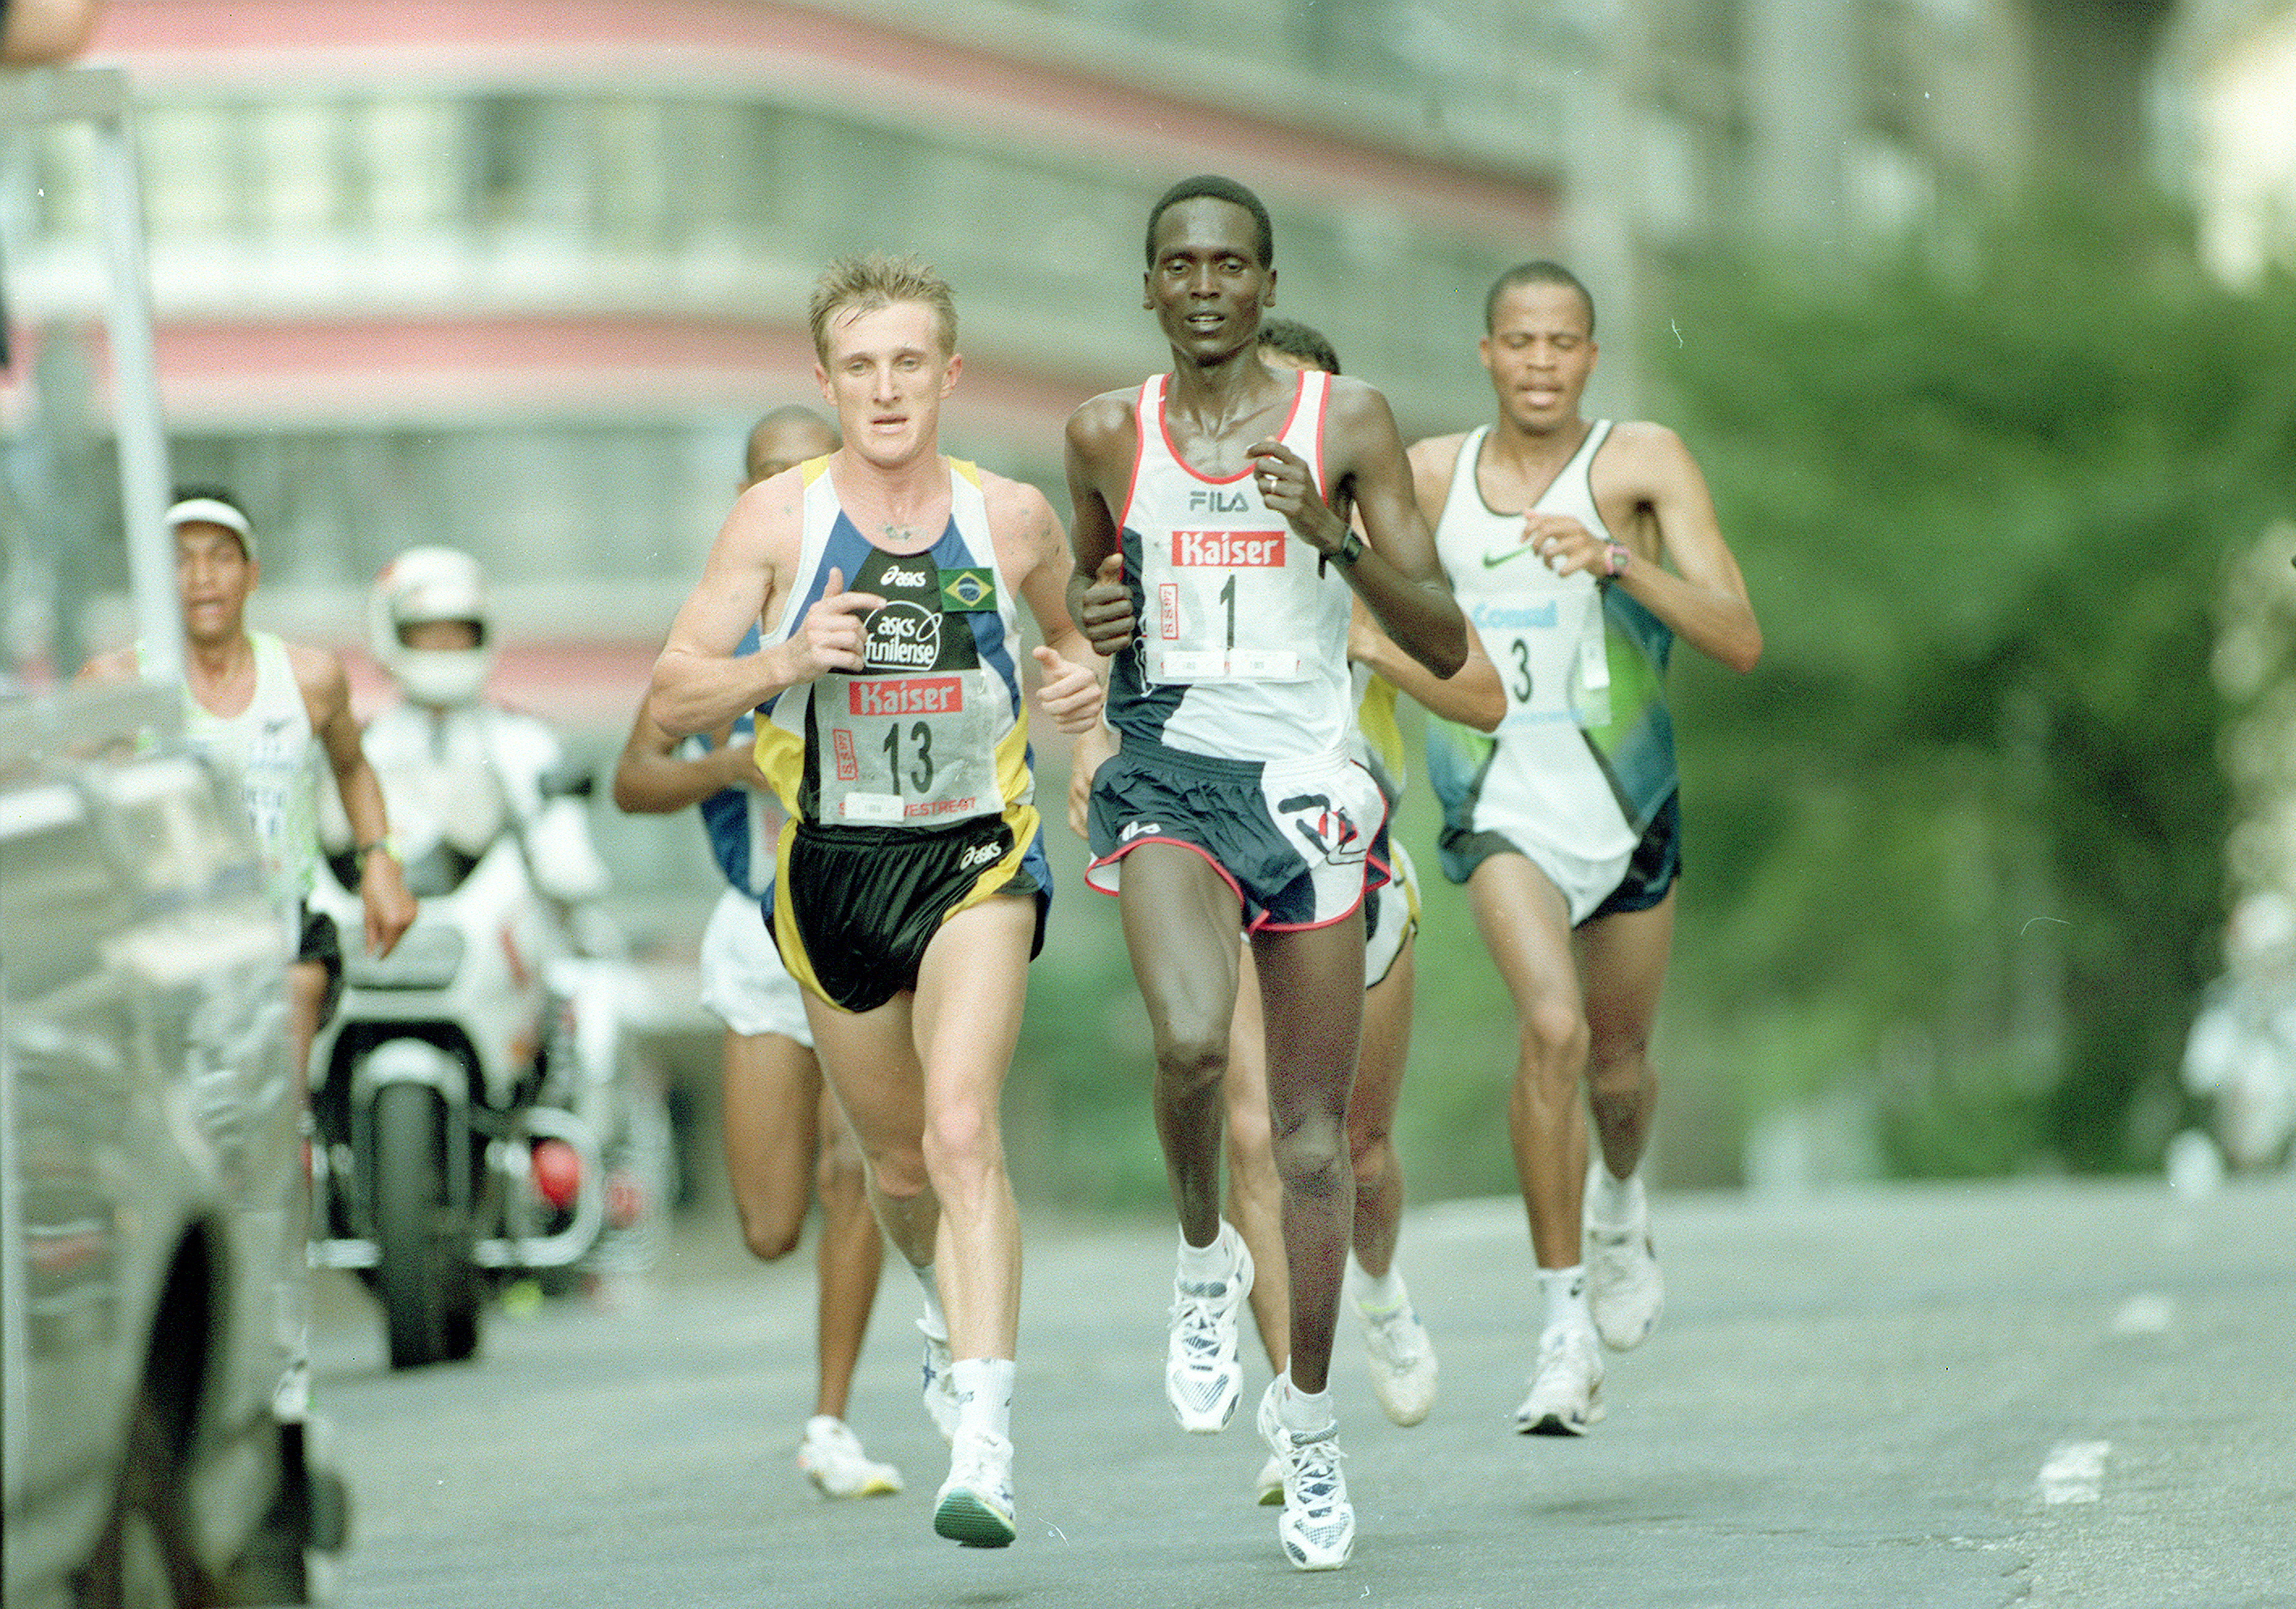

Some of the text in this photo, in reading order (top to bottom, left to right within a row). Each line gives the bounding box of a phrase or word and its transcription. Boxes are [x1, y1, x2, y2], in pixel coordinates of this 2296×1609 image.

[1189, 490, 1249, 512] FILA
[1180, 532, 1280, 566] Kaiser
[877, 616, 916, 638] asics
[1220, 574, 1235, 651] 1
[865, 633, 935, 664] funilense
[1511, 638, 1533, 703] 3
[859, 681, 955, 715] Kaiser
[883, 721, 933, 796] 13
